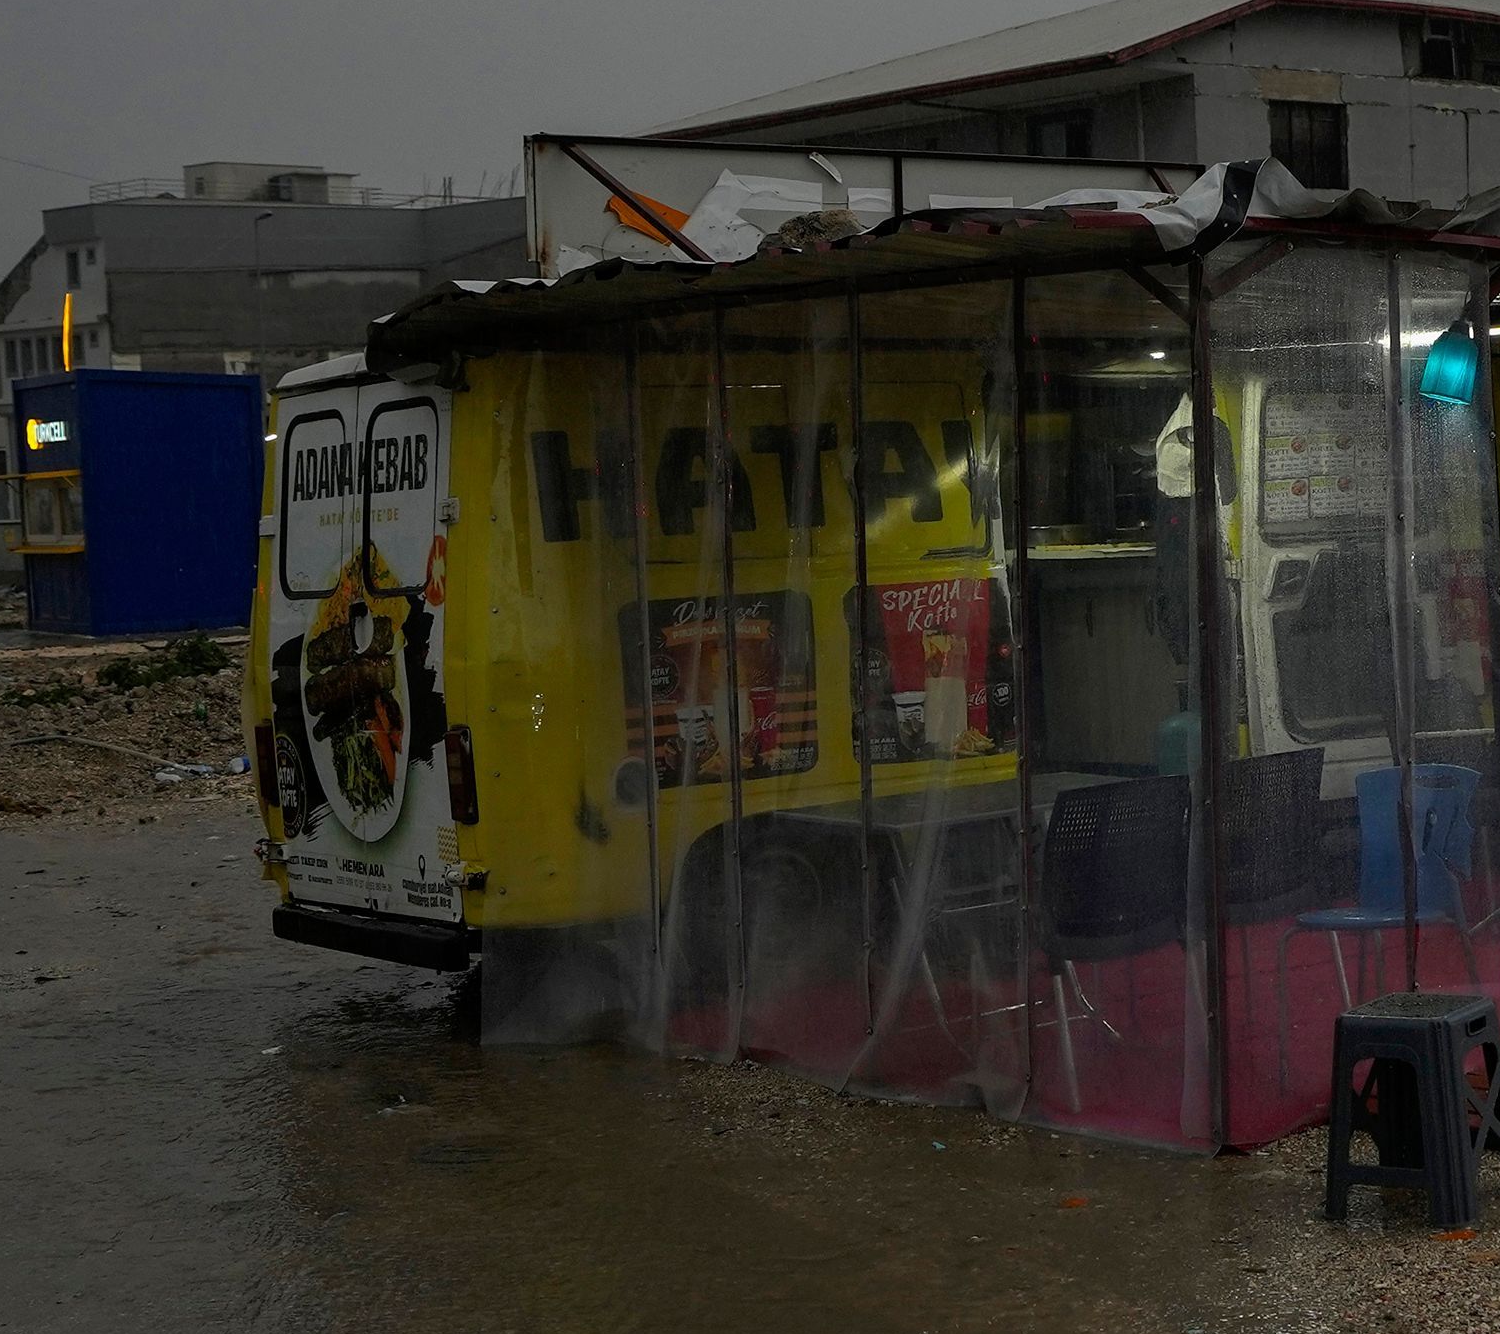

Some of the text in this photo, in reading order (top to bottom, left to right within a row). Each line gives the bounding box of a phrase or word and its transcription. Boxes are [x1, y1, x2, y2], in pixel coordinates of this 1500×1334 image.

[293, 434, 428, 502] ADANA KEBAB
[882, 578, 985, 612] SPECIAL
[342, 859, 385, 878] HEMEN ARA
